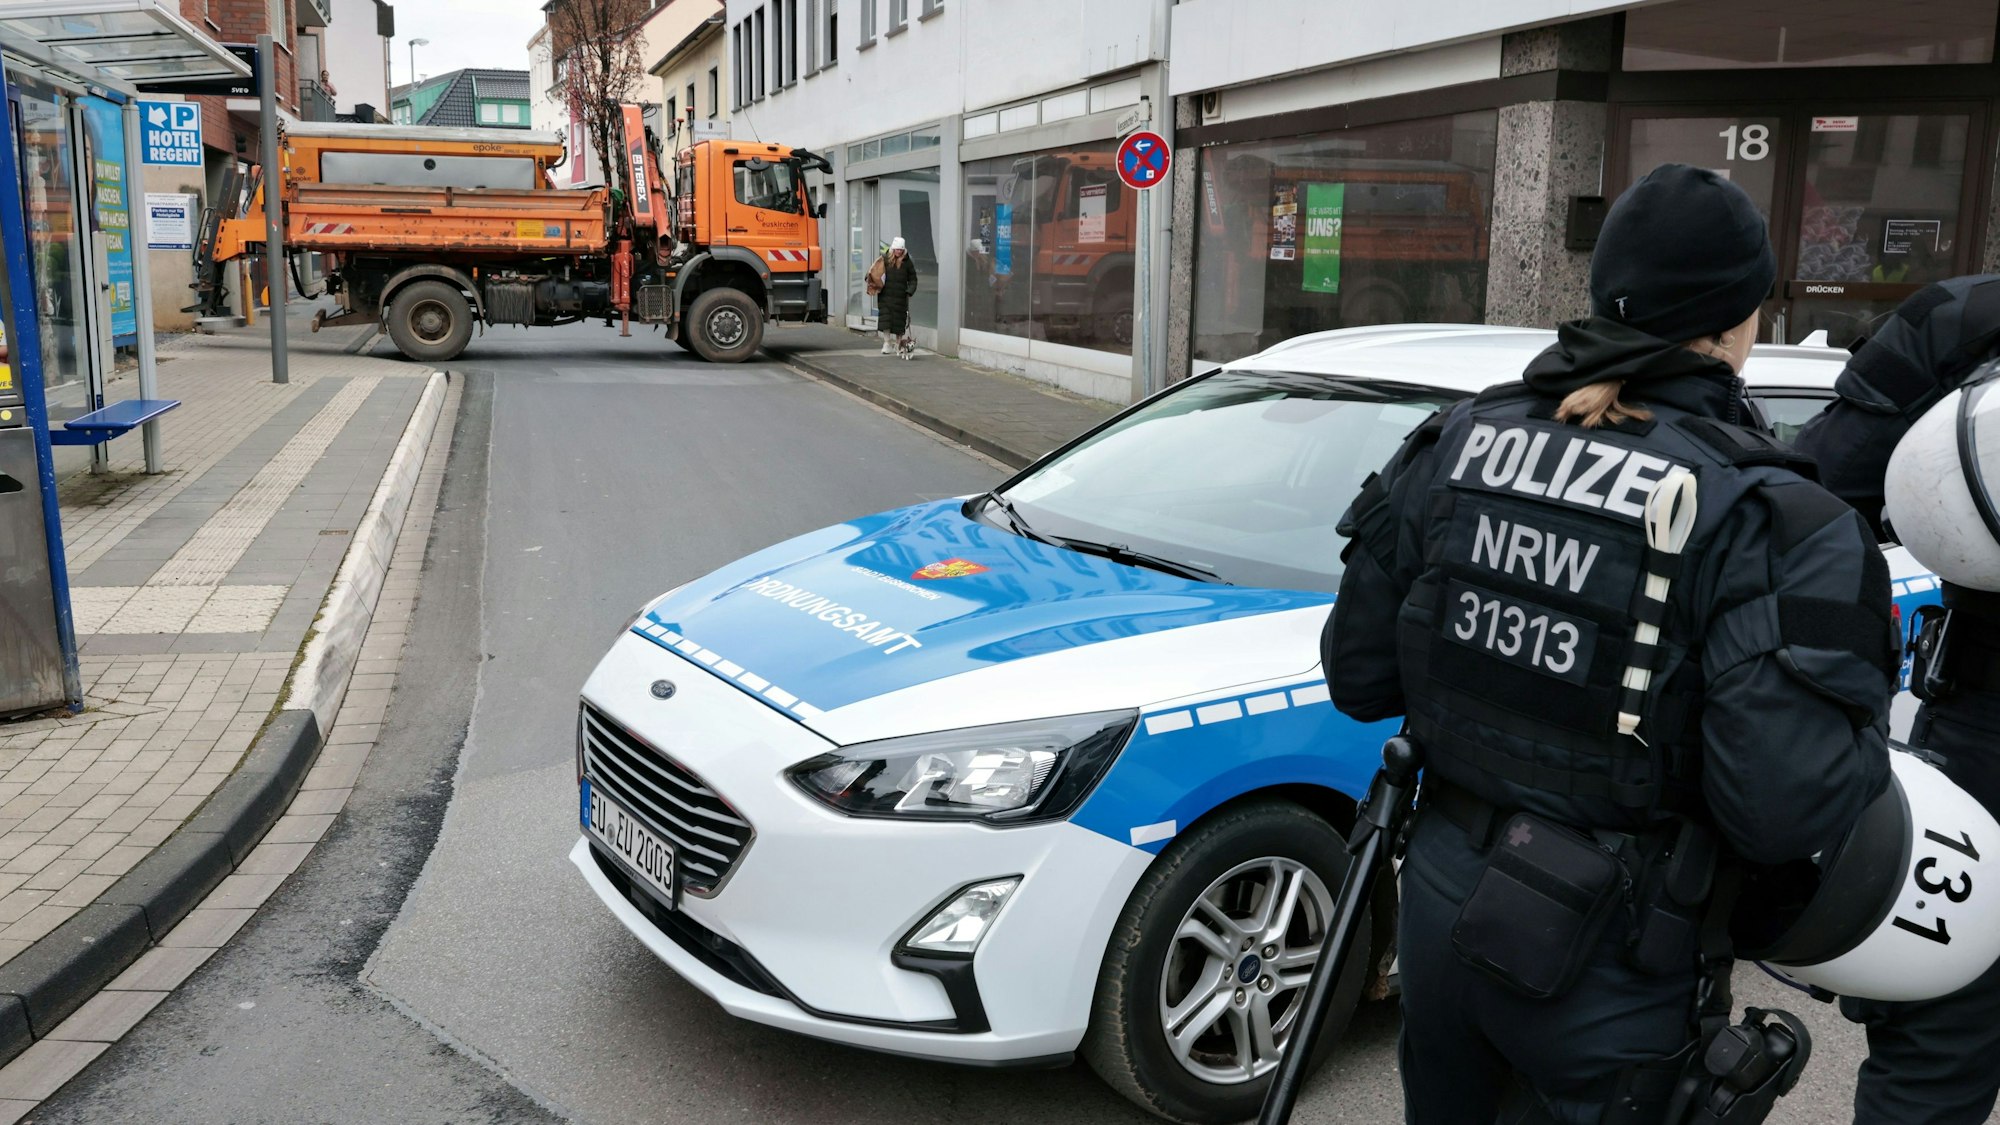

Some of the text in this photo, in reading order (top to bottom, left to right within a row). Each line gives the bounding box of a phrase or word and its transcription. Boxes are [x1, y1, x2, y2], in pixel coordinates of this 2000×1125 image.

[176, 107, 194, 127] P
[149, 130, 199, 148] HOTEL
[473, 143, 502, 153] epoke
[1719, 124, 1770, 161] 18
[150, 147, 199, 163] REGENT
[96, 162, 121, 181] DU WILLST
[635, 165, 647, 202] TEREX
[1308, 218, 1342, 237] UNS?
[1806, 284, 1845, 294] DRÜCKEN
[1471, 514, 1600, 594] NRW
[1454, 591, 1580, 674] 31313
[590, 790, 606, 836] EU
[616, 811, 633, 859] EU
[636, 828, 673, 891] 2003
